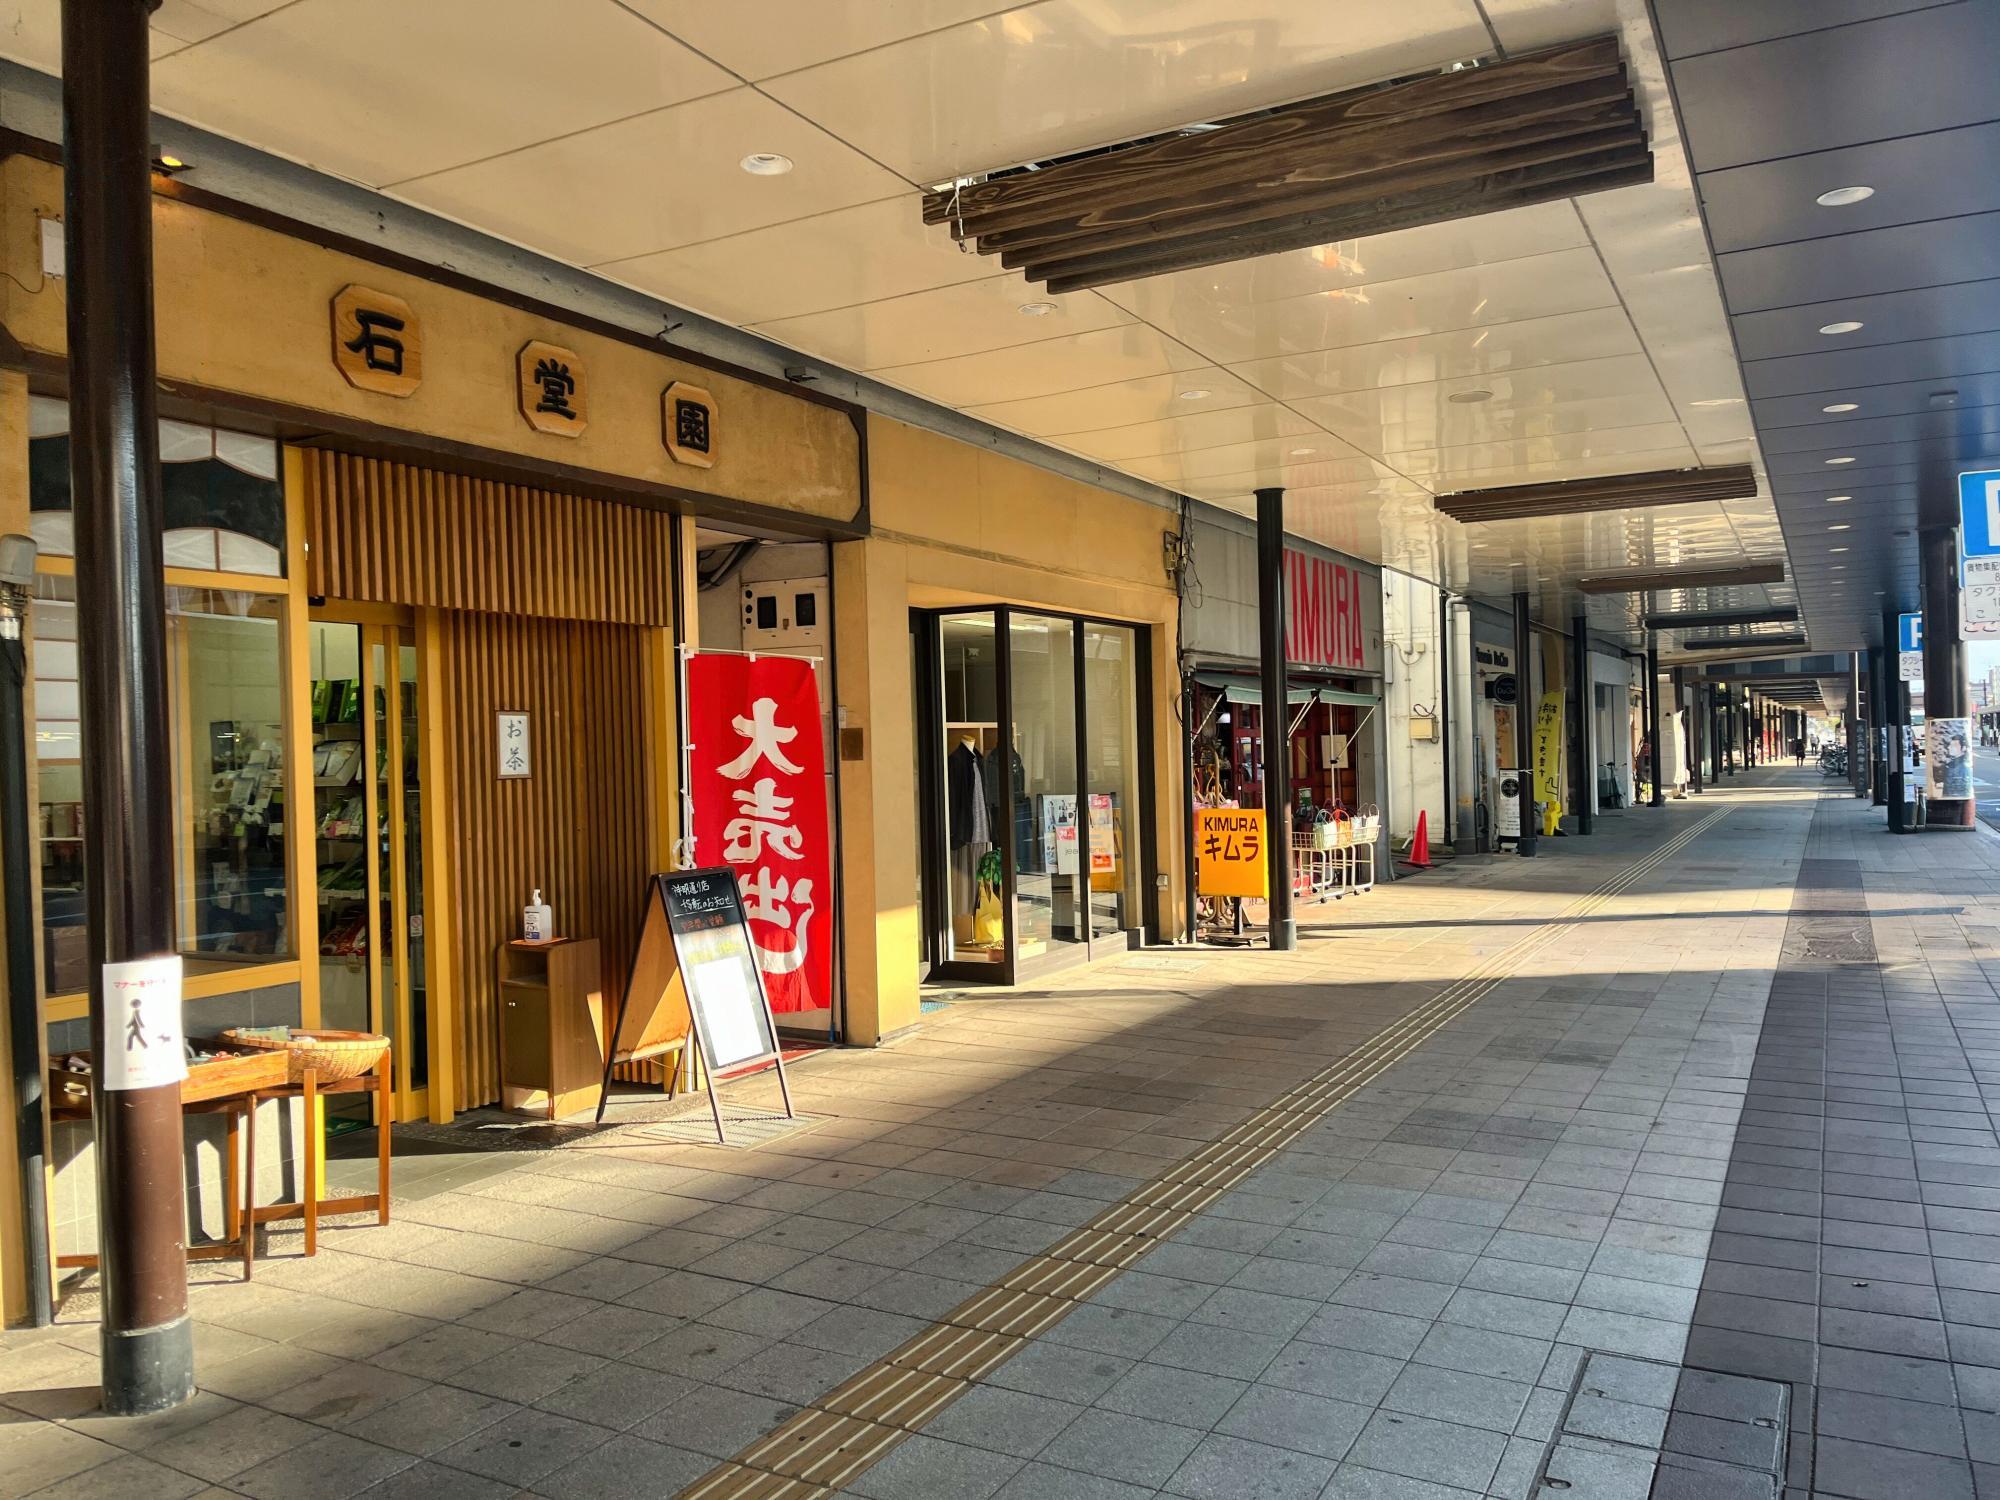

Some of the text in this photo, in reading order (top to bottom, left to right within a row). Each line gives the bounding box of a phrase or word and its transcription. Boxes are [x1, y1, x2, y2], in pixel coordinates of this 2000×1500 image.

[1967, 563, 2000, 573] 貨物集配
[1973, 586, 2000, 597] タク
[505, 719, 524, 771] お茶
[1204, 816, 1259, 832] KIMURA
[716, 697, 813, 974] 大売出し
[1205, 834, 1259, 862] キムラ
